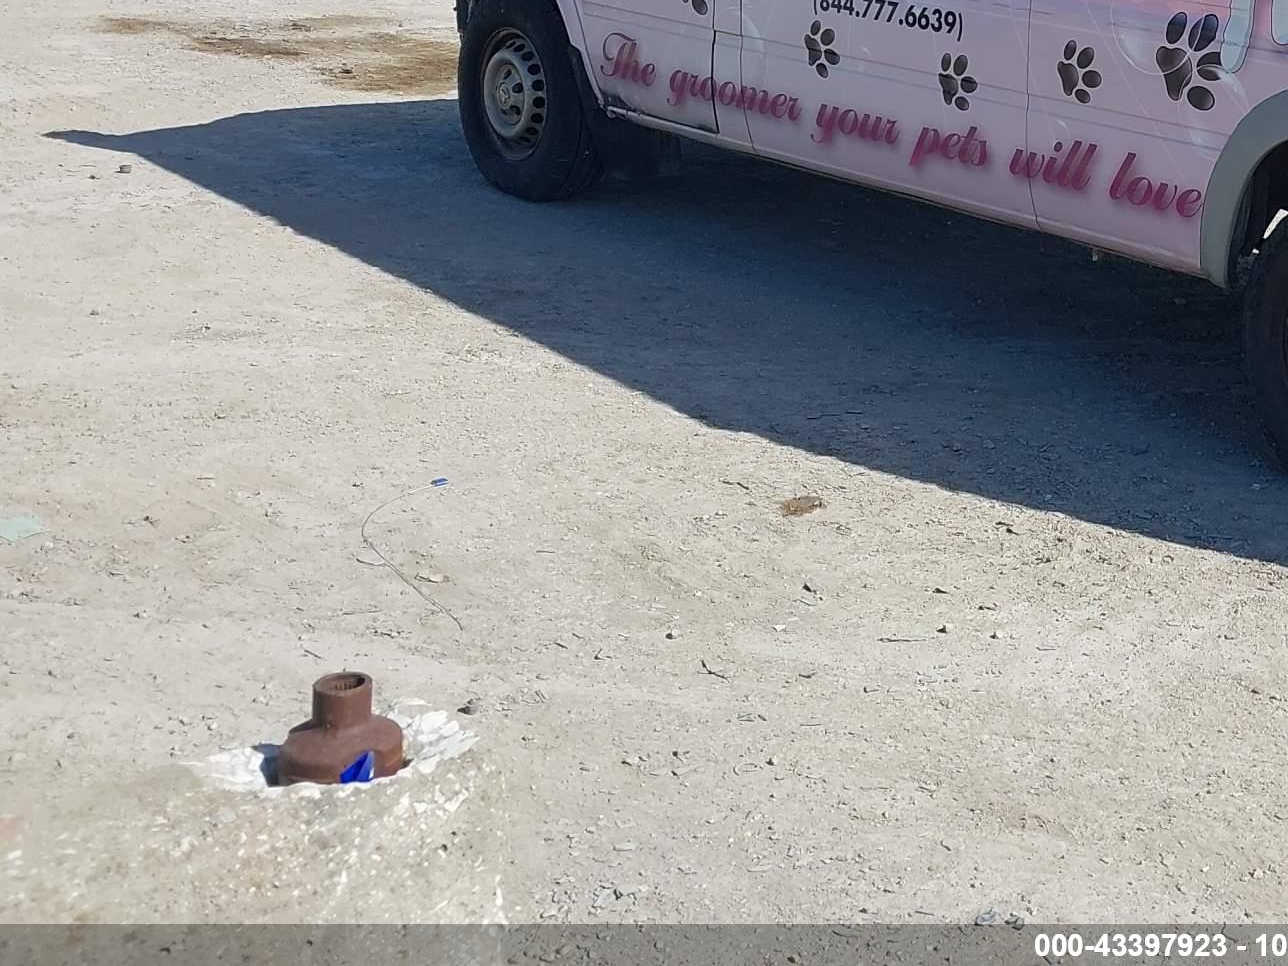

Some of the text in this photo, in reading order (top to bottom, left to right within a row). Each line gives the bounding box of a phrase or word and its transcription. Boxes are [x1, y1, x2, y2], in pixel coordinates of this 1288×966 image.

[599, 32, 1202, 218] The groomer your pets will love
